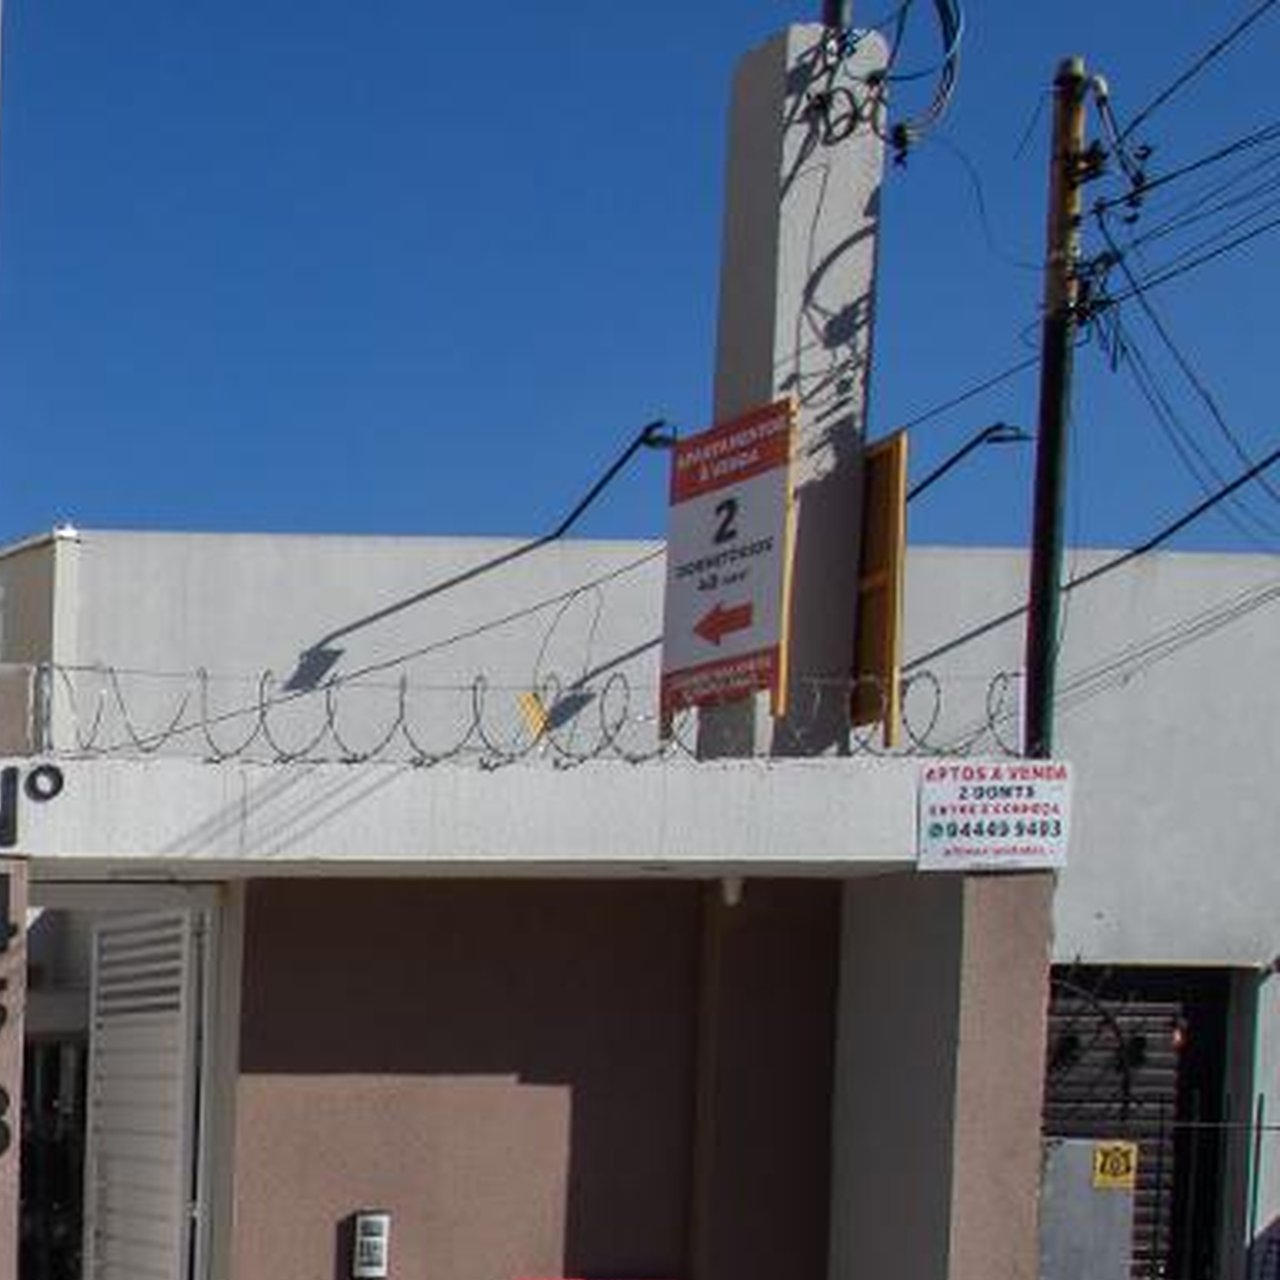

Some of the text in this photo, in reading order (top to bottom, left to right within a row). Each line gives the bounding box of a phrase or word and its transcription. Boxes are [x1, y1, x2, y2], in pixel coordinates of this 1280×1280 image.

[713, 496, 738, 543] 2
[926, 765, 987, 782] APTOS
[1007, 763, 1068, 781] VENDA
